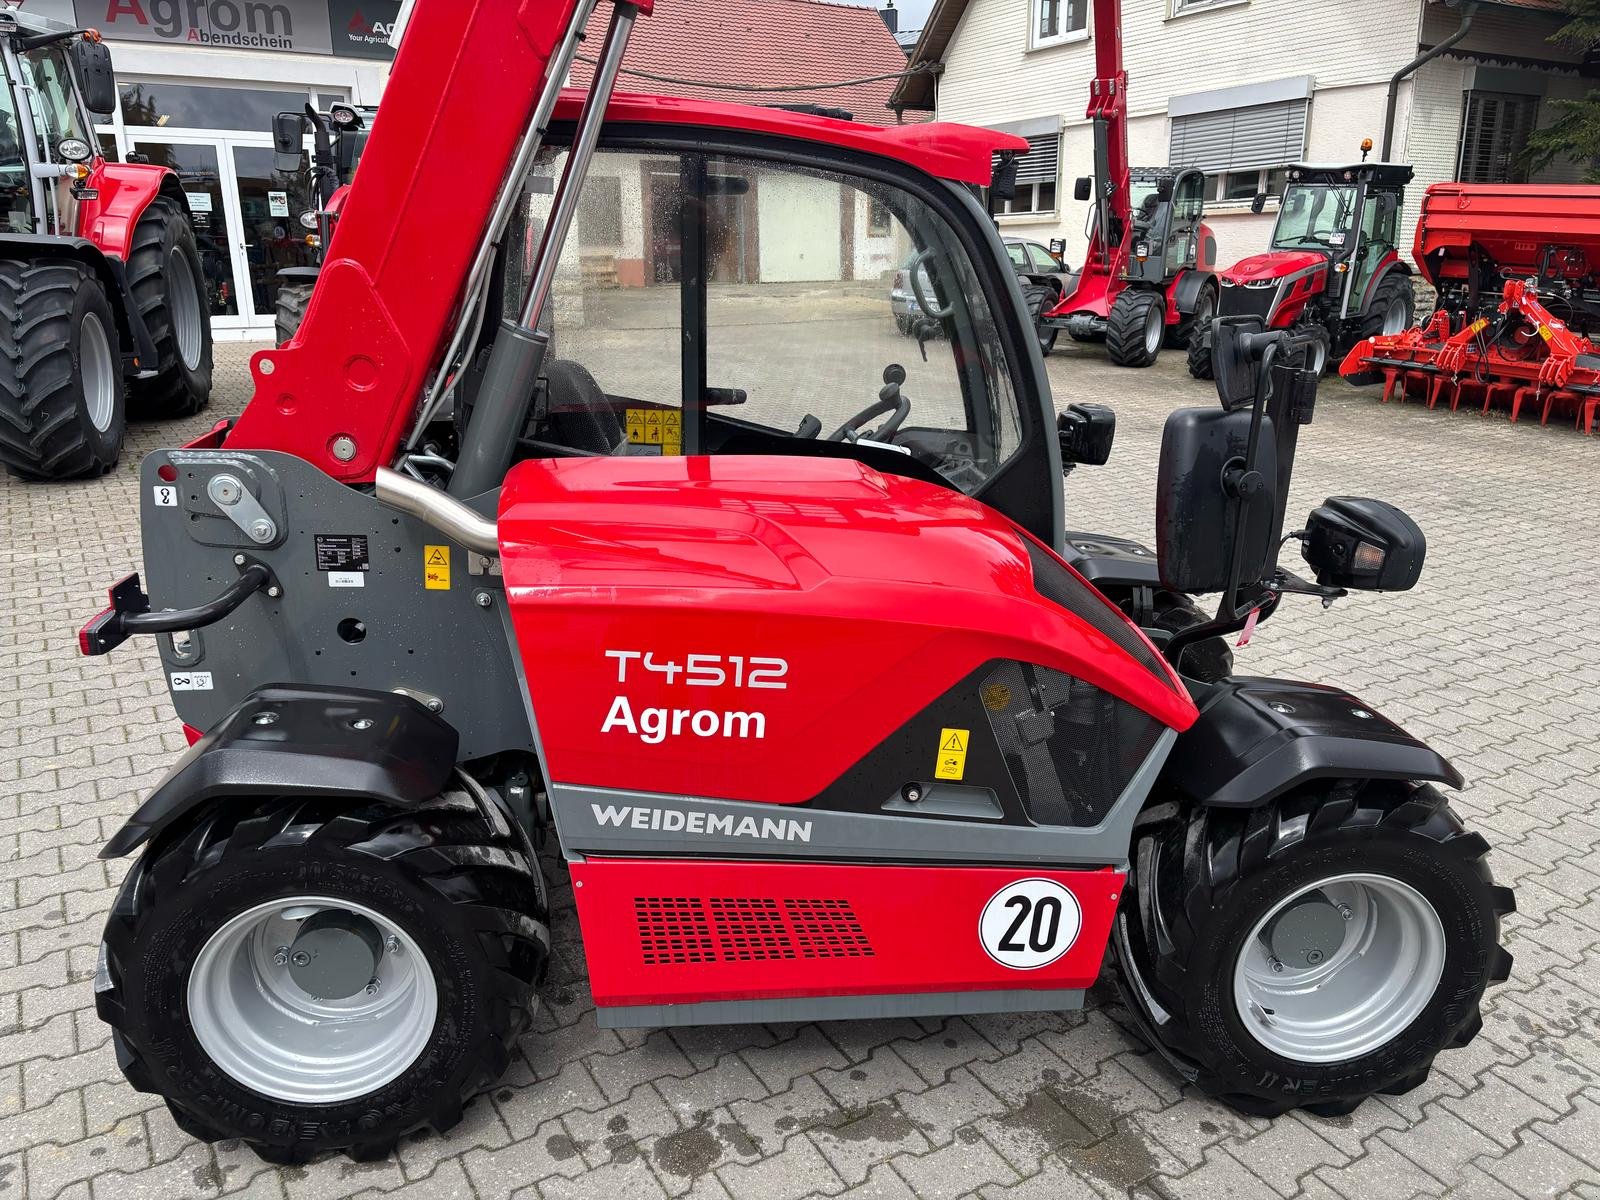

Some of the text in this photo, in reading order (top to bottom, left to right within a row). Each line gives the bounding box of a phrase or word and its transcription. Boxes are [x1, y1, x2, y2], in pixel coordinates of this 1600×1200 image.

[106, 0, 293, 38] Agrom
[187, 28, 293, 48] Abendschein
[348, 33, 363, 42] Your
[604, 650, 788, 689] T4512
[601, 696, 766, 744] Agrom
[591, 803, 813, 842] WEIDEMANN
[998, 895, 1062, 953] 20
